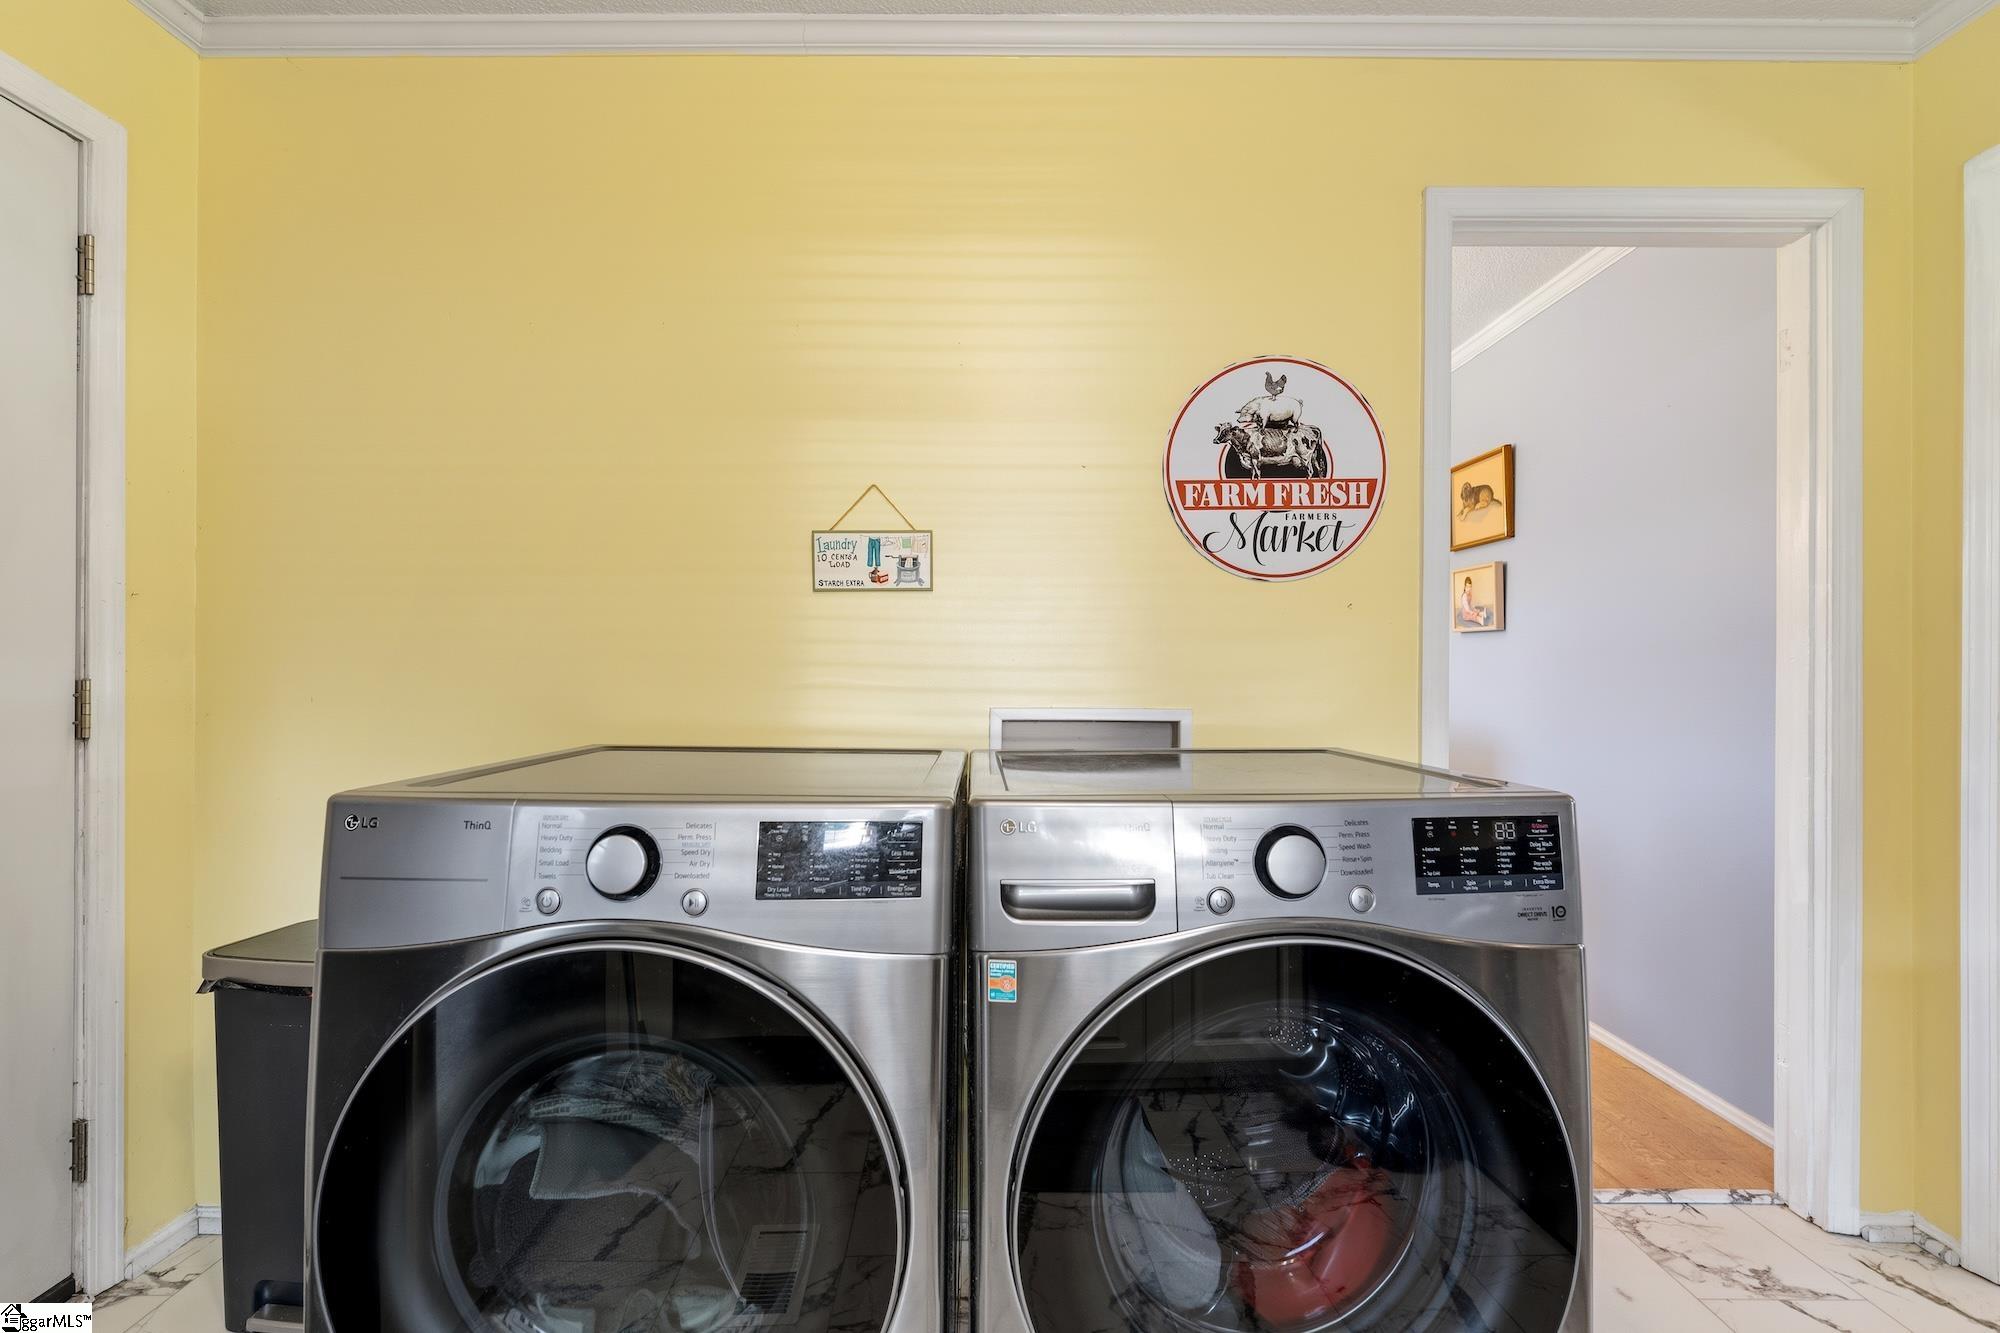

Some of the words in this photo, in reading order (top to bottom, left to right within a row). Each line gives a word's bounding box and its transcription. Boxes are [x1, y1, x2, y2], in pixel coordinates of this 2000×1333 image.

[1184, 482, 1268, 508] FARM
[1273, 482, 1370, 508] FRESH
[1202, 510, 1356, 566] Market
[816, 537, 858, 554] Laundry
[817, 554, 828, 562] 10
[362, 816, 378, 828] LG
[464, 820, 492, 830] ThinQ
[1018, 822, 1038, 834] LG
[1552, 906, 1566, 918] 10
